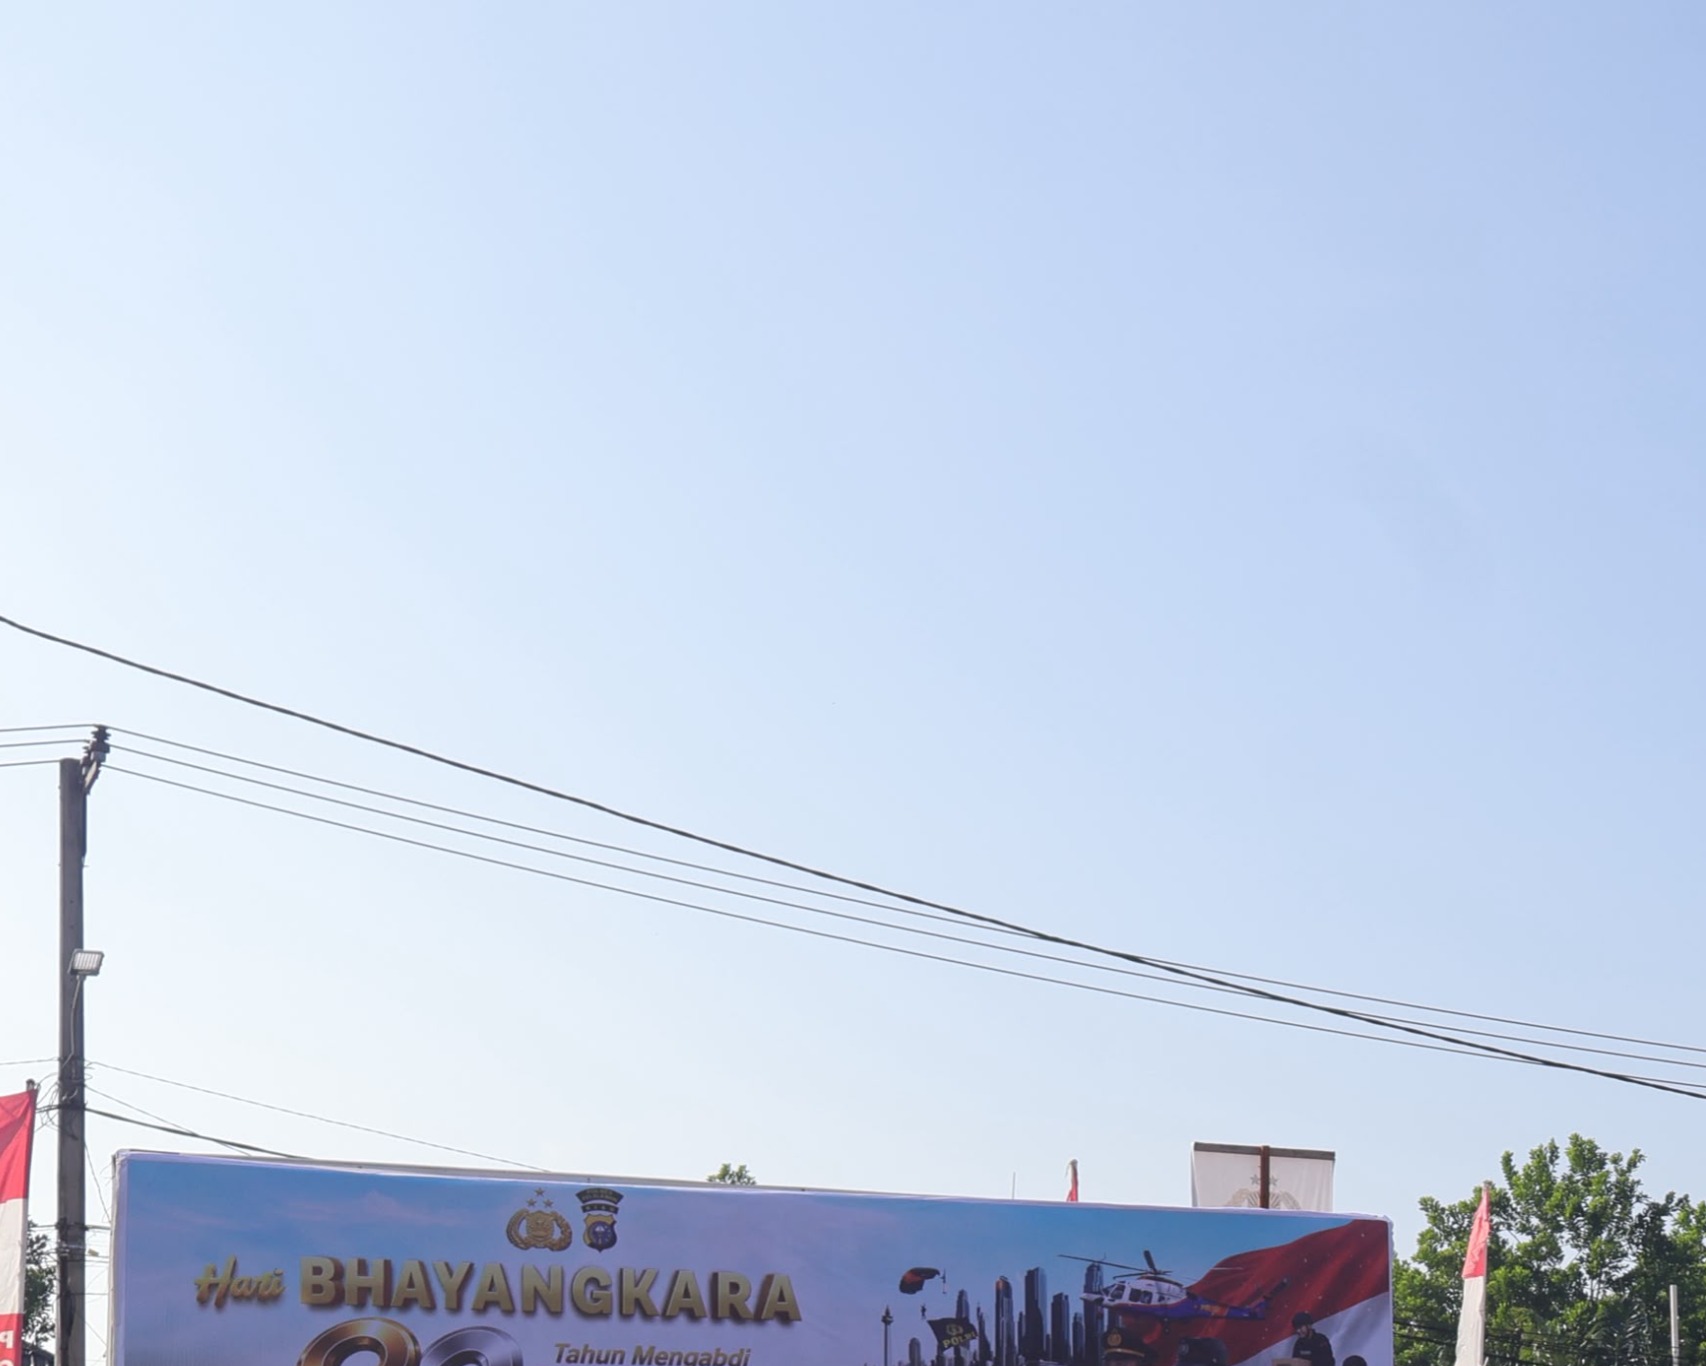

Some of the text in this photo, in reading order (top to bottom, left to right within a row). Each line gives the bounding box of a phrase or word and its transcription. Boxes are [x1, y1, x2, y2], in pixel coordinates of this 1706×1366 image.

[195, 1255, 802, 1323] Hari BHAYANGKARA
[554, 1343, 625, 1366] Tahun
